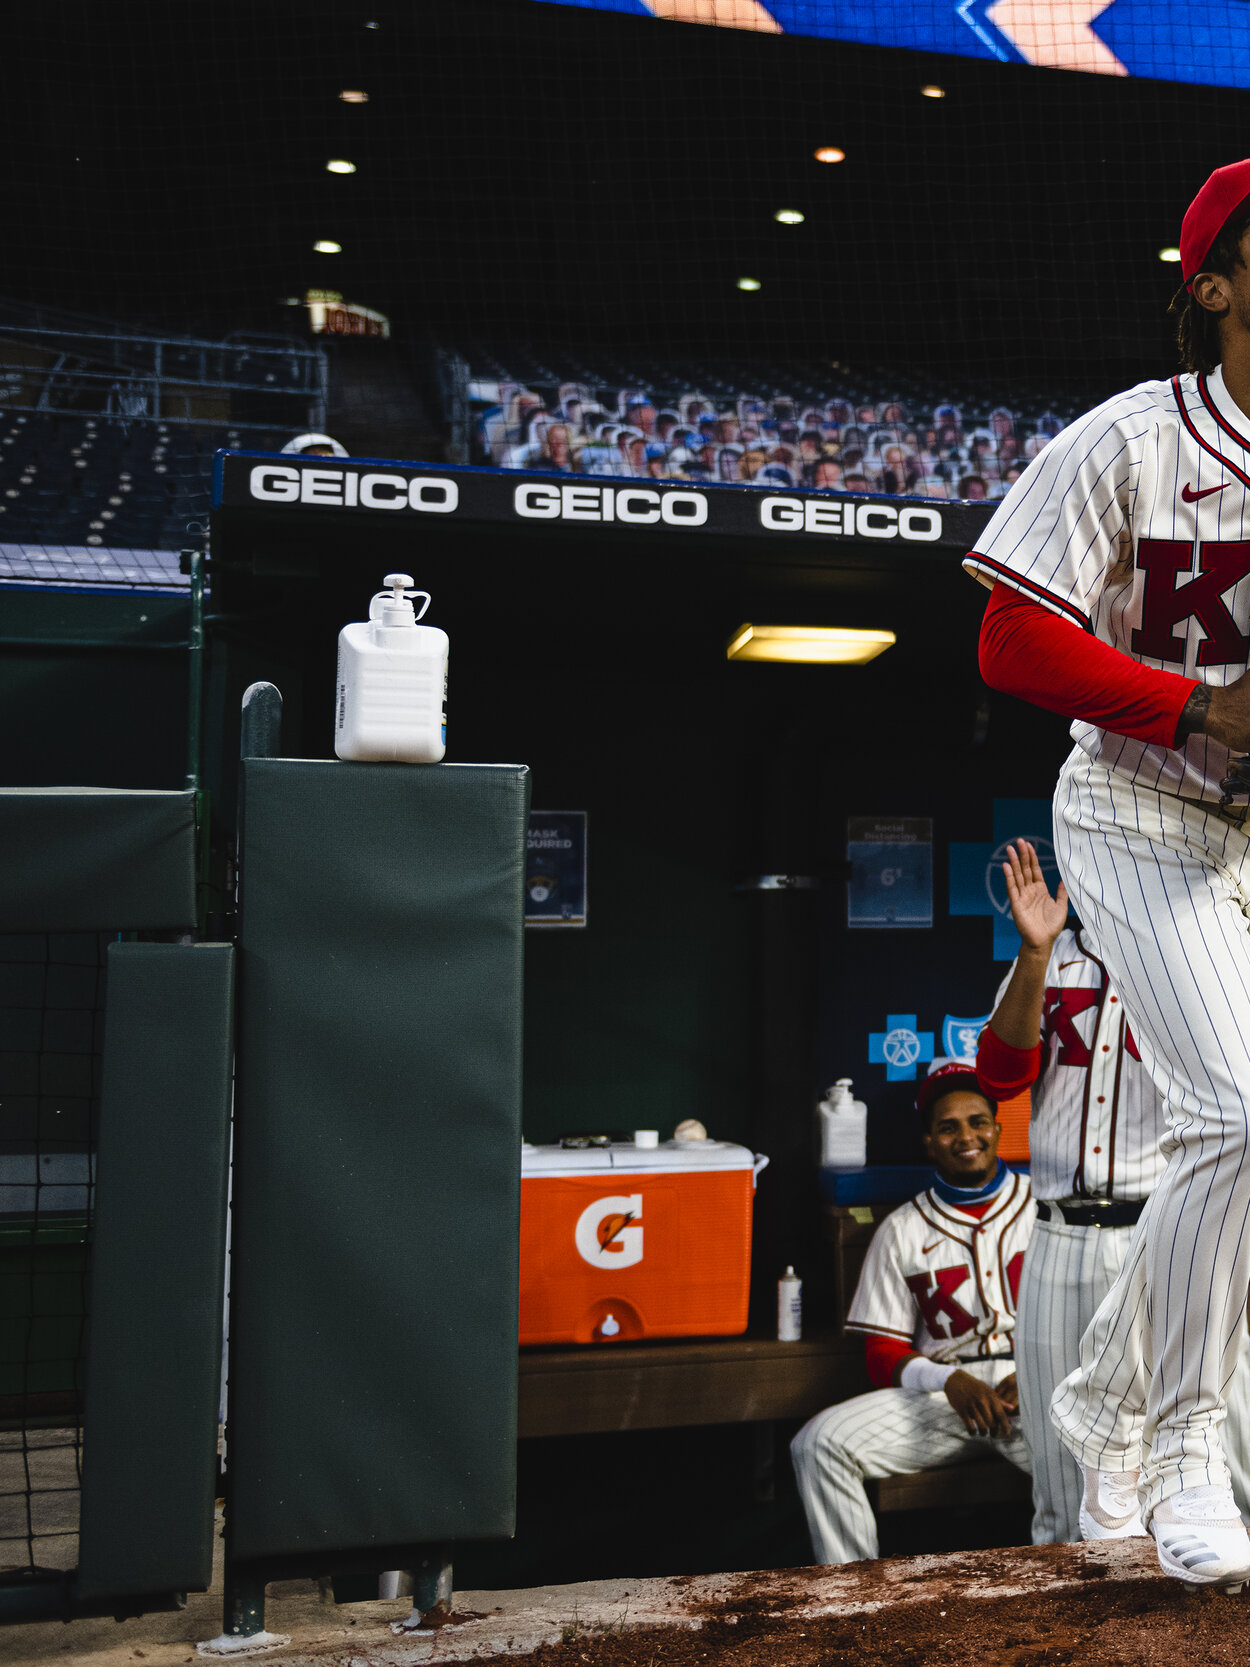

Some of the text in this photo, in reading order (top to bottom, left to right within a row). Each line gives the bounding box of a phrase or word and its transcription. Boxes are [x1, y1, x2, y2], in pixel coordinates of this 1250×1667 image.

[250, 464, 459, 513] GEICO
[514, 482, 708, 527] GEICO
[760, 496, 943, 542] GEICO
[574, 1193, 644, 1270] G
